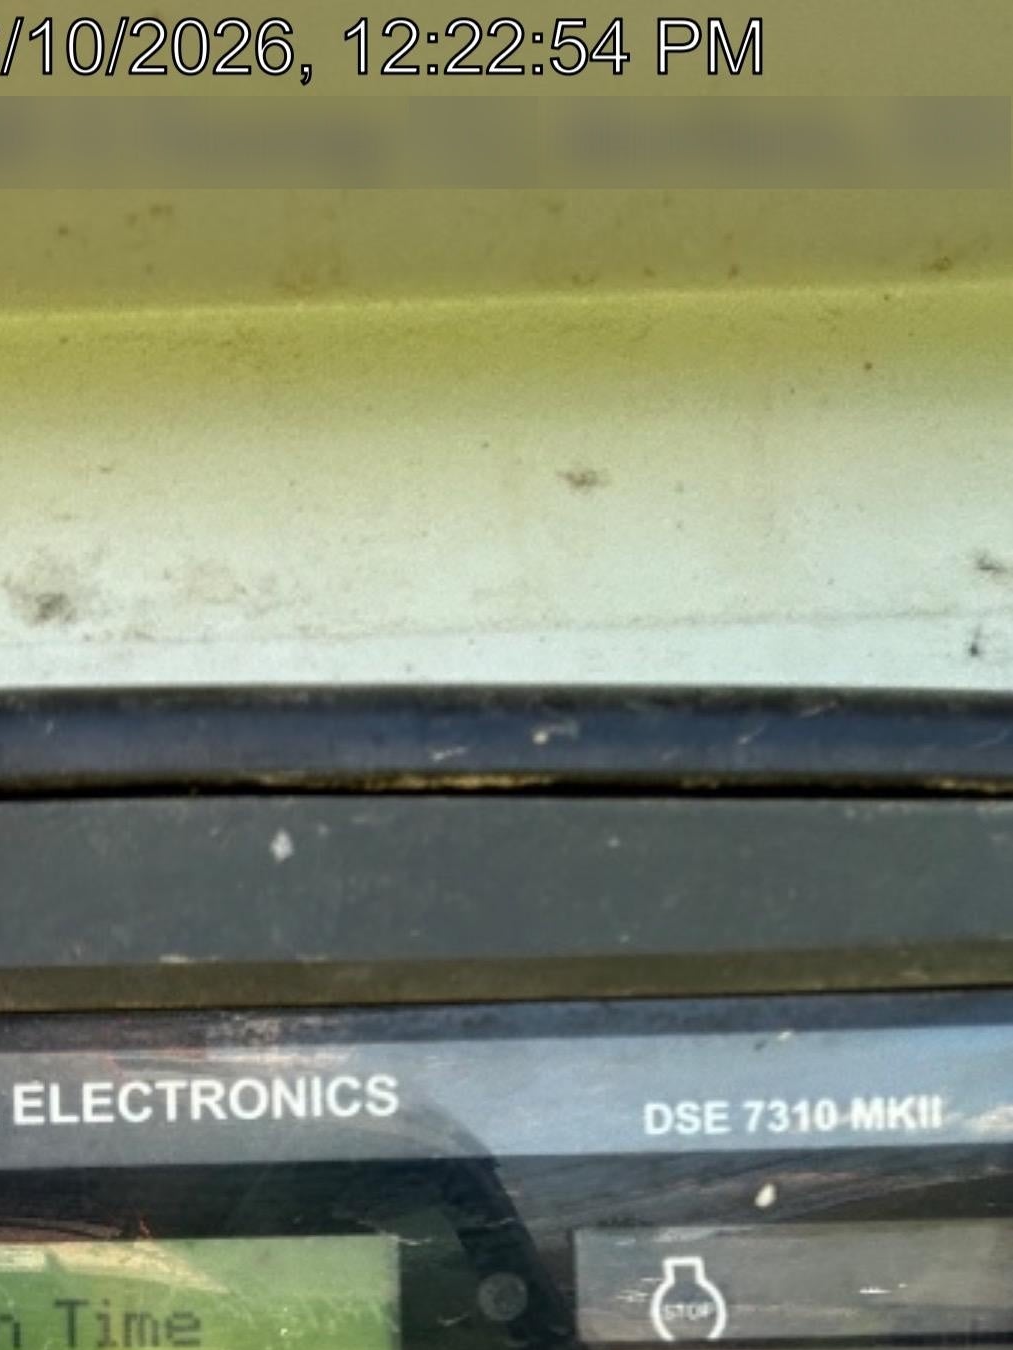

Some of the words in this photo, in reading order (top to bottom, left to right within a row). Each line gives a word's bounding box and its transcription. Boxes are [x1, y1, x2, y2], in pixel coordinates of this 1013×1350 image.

[12, 1073, 399, 1126] ELECTRONICS
[644, 1100, 730, 1135] DSE
[745, 1098, 839, 1132] 7310
[850, 1095, 942, 1130] MKII
[53, 1296, 203, 1349] Time
